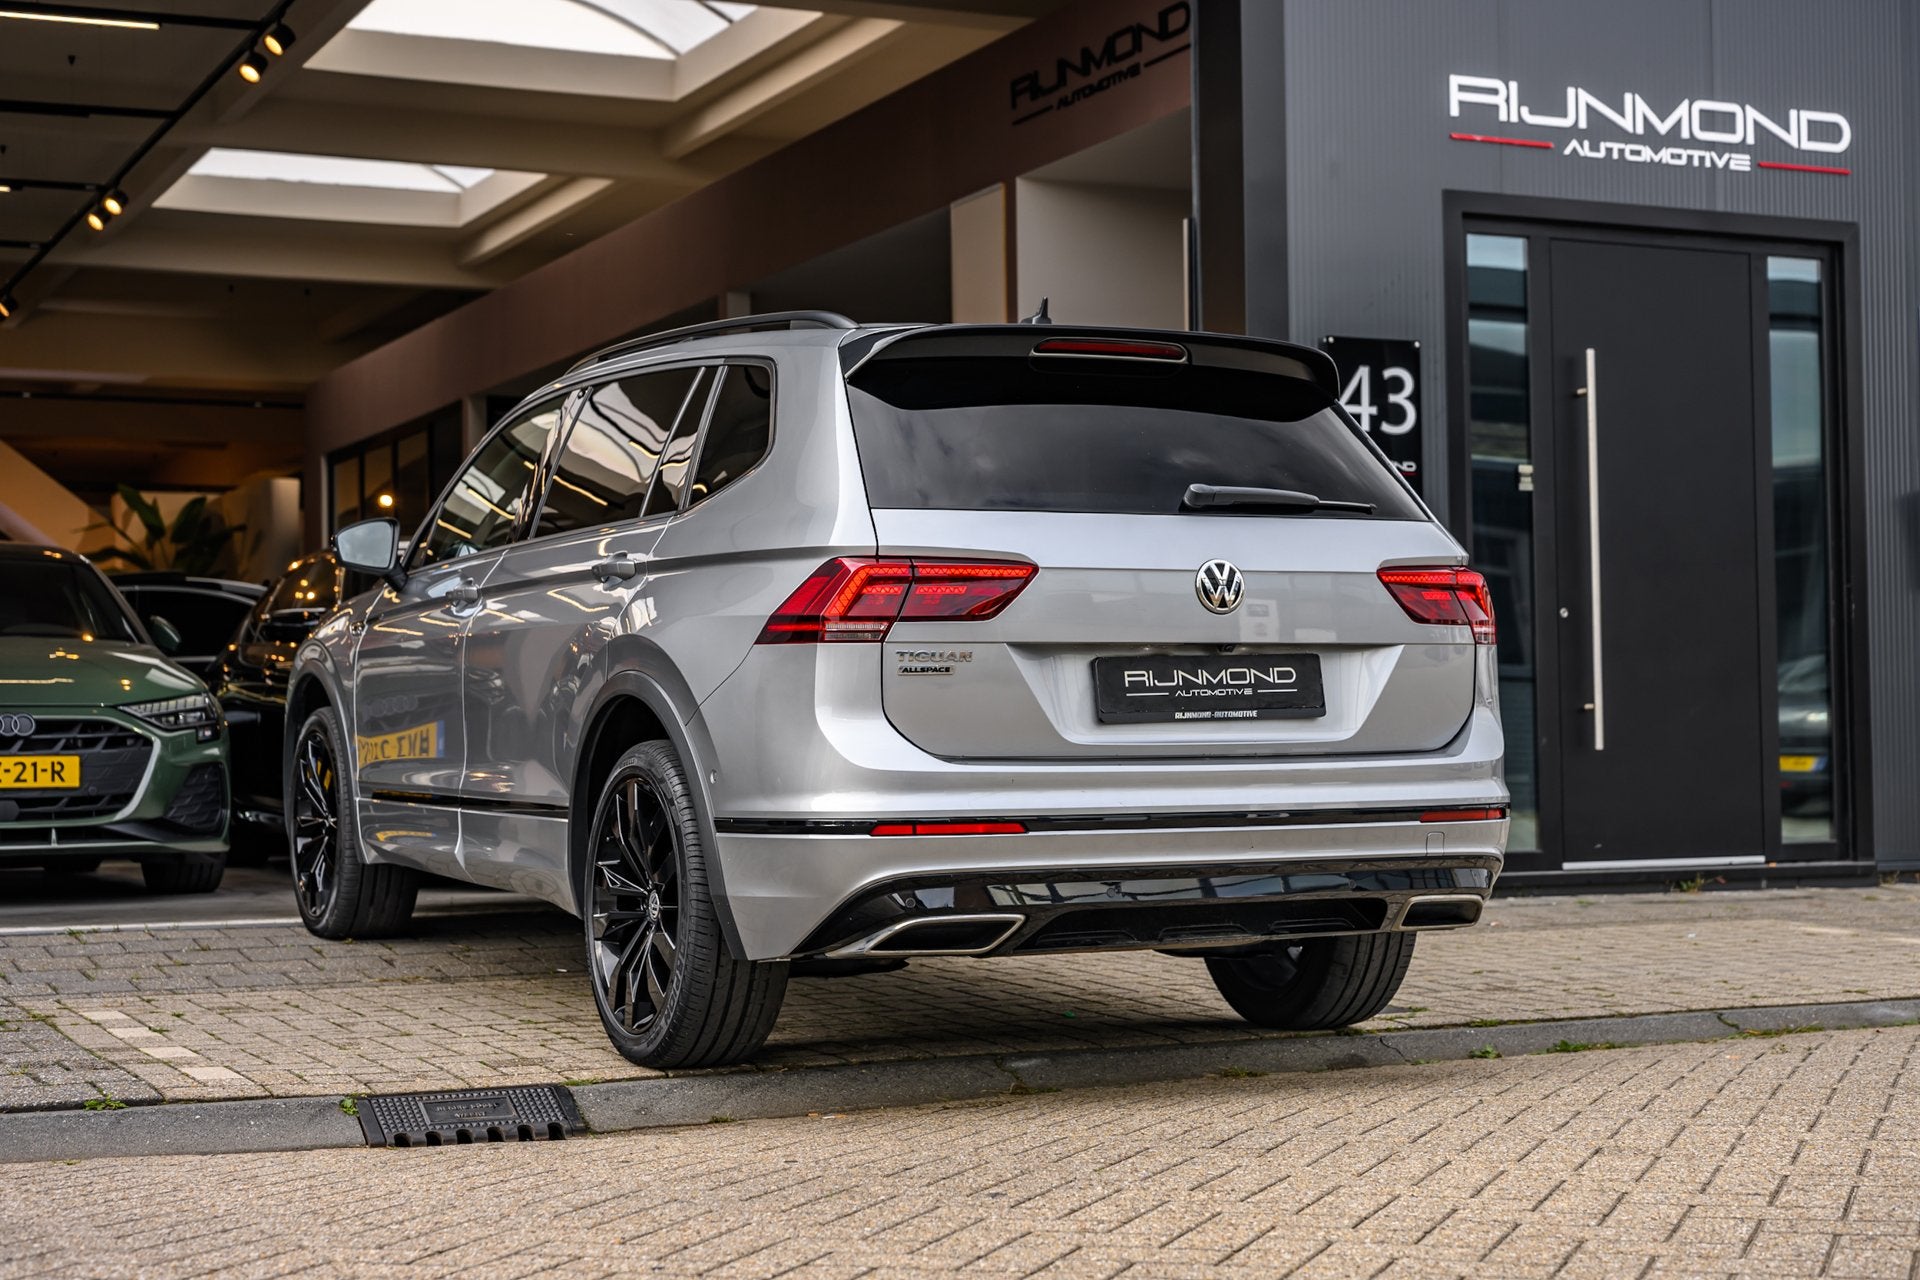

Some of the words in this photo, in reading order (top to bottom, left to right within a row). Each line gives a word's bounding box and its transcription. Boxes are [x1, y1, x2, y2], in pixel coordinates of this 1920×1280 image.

[1010, 1, 1191, 110] RIJNMOND
[1056, 62, 1141, 110] AUTOMOTIVE
[1448, 73, 1852, 154] RIJNMOND
[1563, 138, 1751, 171] AUTOMOTIVE
[1339, 365, 1417, 436] 43
[896, 650, 973, 662] TIGUAN
[1124, 667, 1297, 687] RIJNMOND
[1175, 688, 1253, 697] AUTOMOTIVE
[0, 761, 65, 783] -21-R
